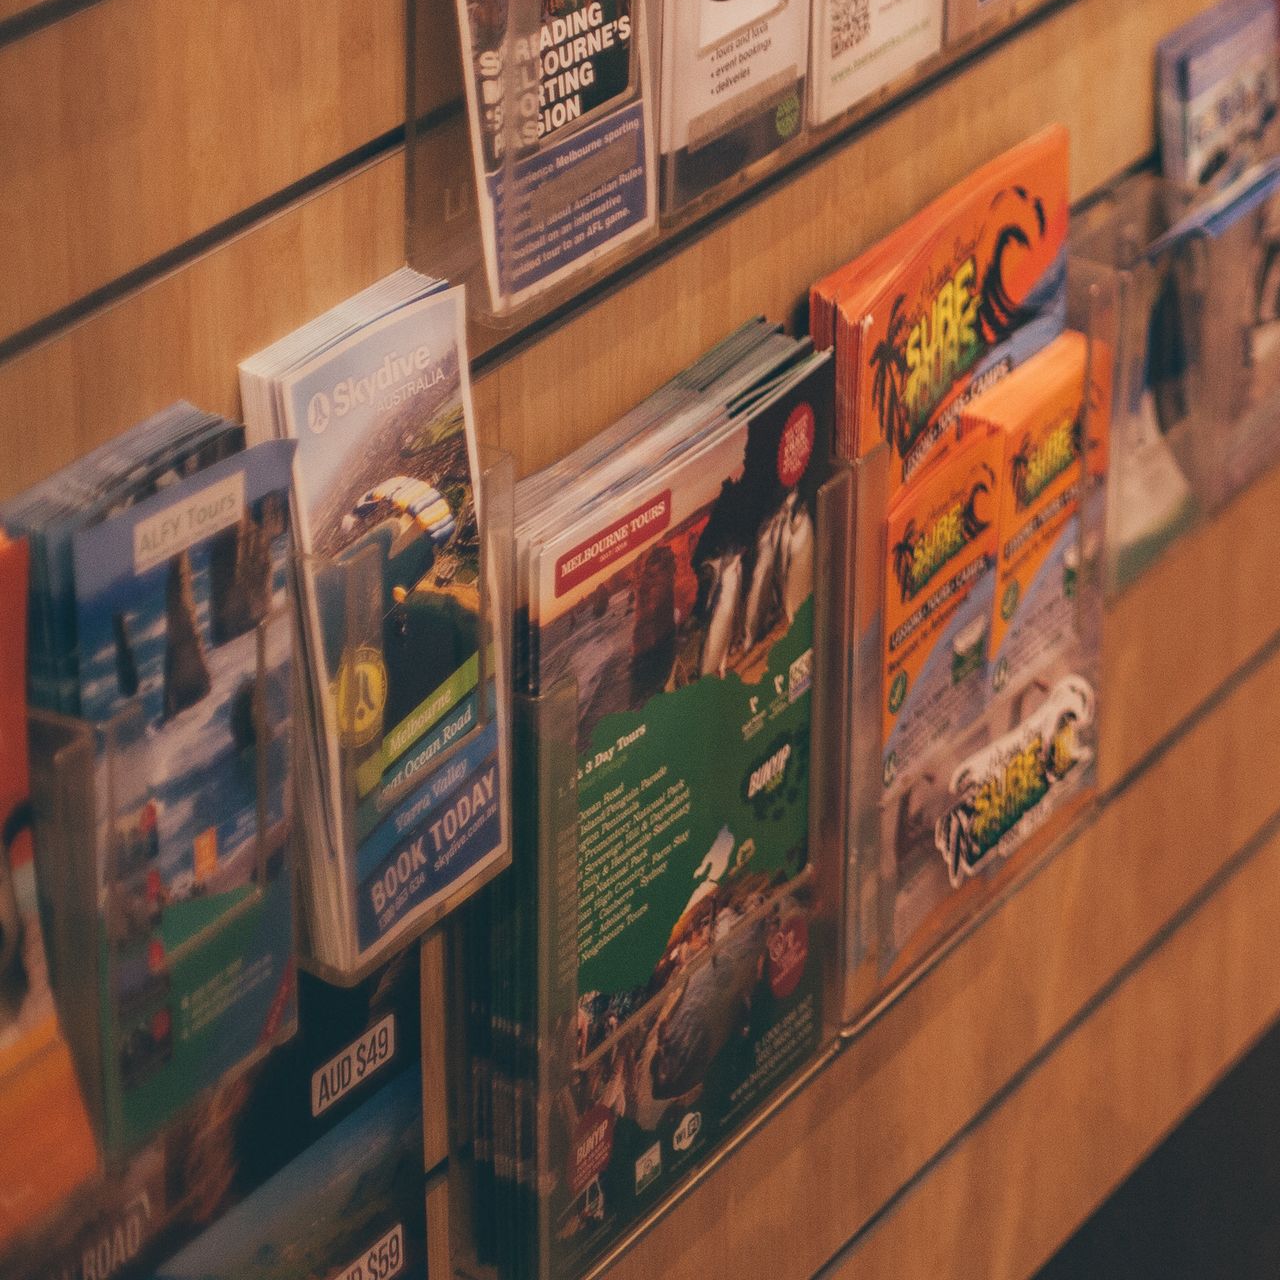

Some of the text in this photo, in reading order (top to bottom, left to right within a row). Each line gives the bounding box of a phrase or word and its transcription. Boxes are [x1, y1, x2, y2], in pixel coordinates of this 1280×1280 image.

[555, 118, 640, 169] Melbourne sporting
[574, 166, 643, 210] Australian Rules
[562, 238, 573, 250] to
[586, 220, 605, 237] AFL
[906, 256, 980, 370] SURF
[332, 344, 431, 417] Skydive
[375, 368, 446, 412] AUSTRALIA
[561, 501, 666, 577] MELBOURNE TOURS
[388, 688, 453, 757] Melbourne
[404, 703, 473, 778] Ocean Road
[594, 724, 646, 768] Day Tours
[431, 757, 469, 798] Valley
[370, 768, 497, 915] BOOK TODAY
[432, 801, 498, 872] skydive.com.au
[317, 1026, 389, 1108] AUD $49
[366, 1233, 400, 1280] $59
